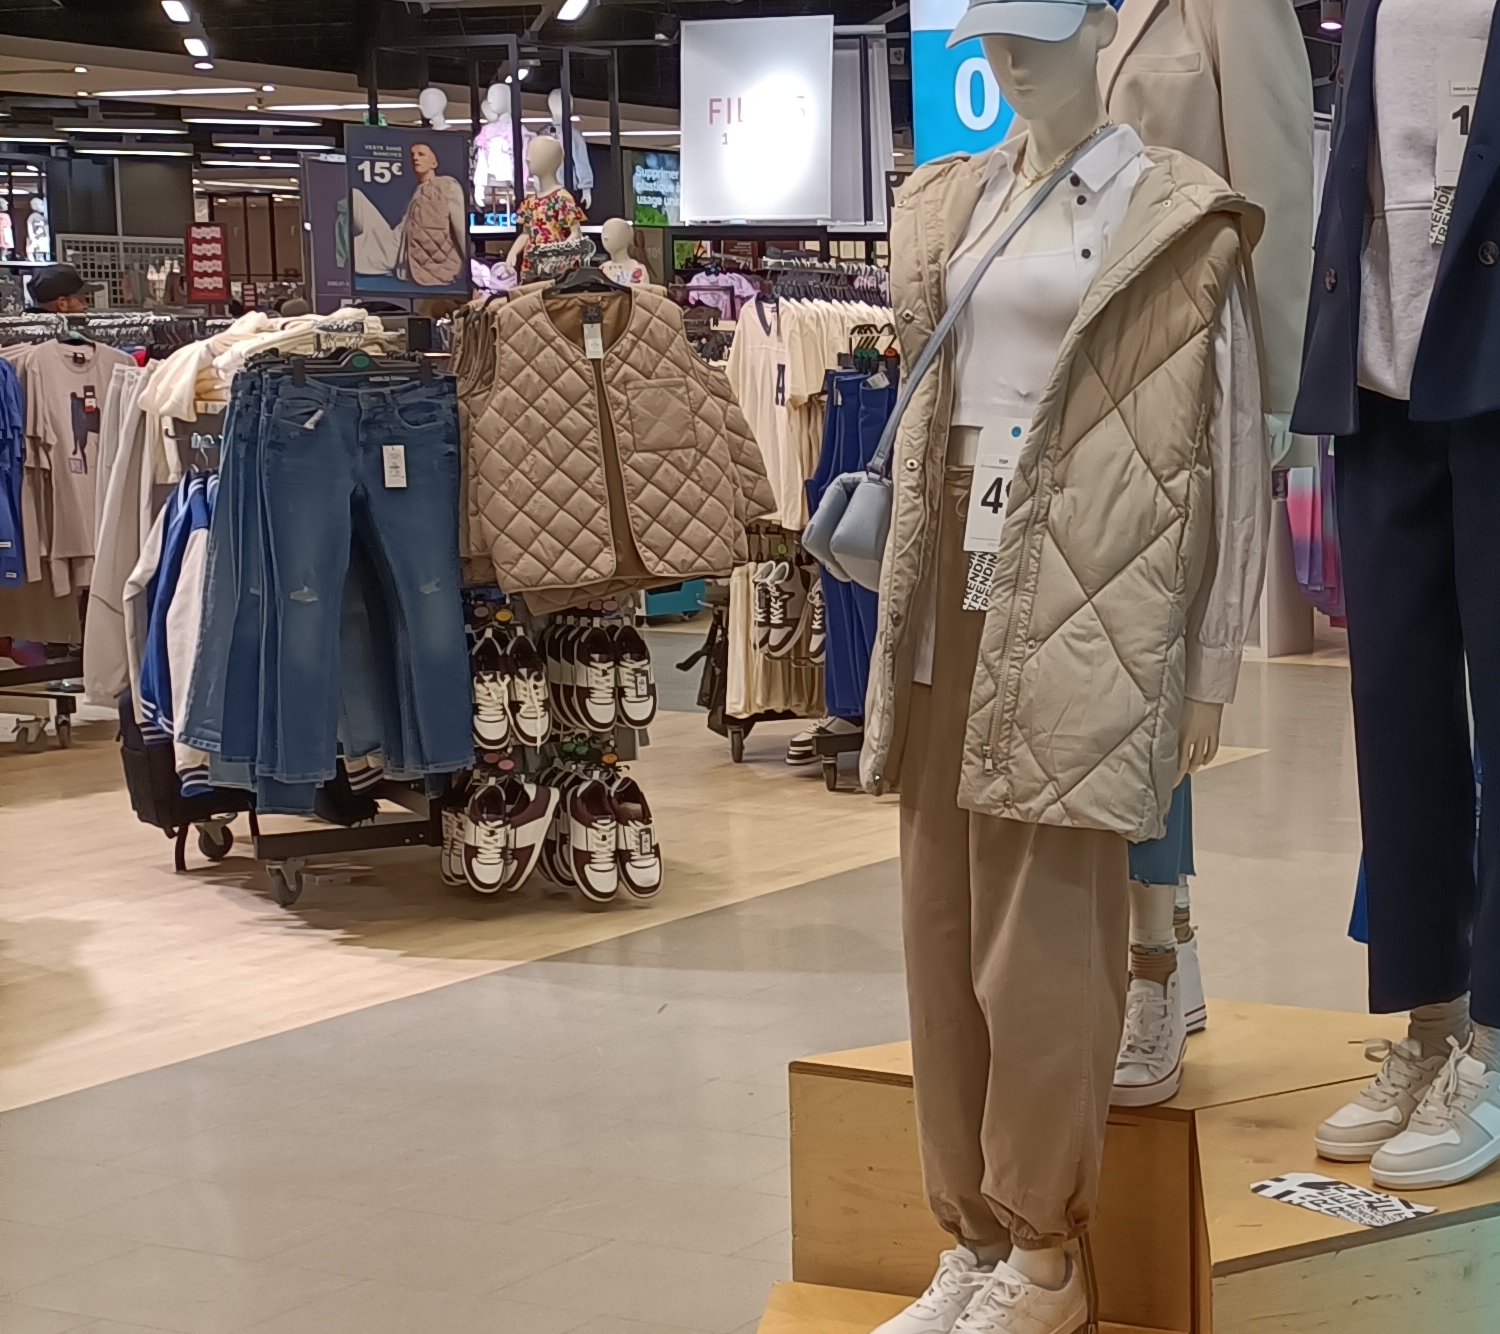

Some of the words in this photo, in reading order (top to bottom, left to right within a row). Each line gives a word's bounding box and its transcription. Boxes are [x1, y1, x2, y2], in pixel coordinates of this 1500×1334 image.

[357, 160, 402, 184] 15€
[635, 165, 679, 180] Supprimer
[637, 195, 662, 208] usage
